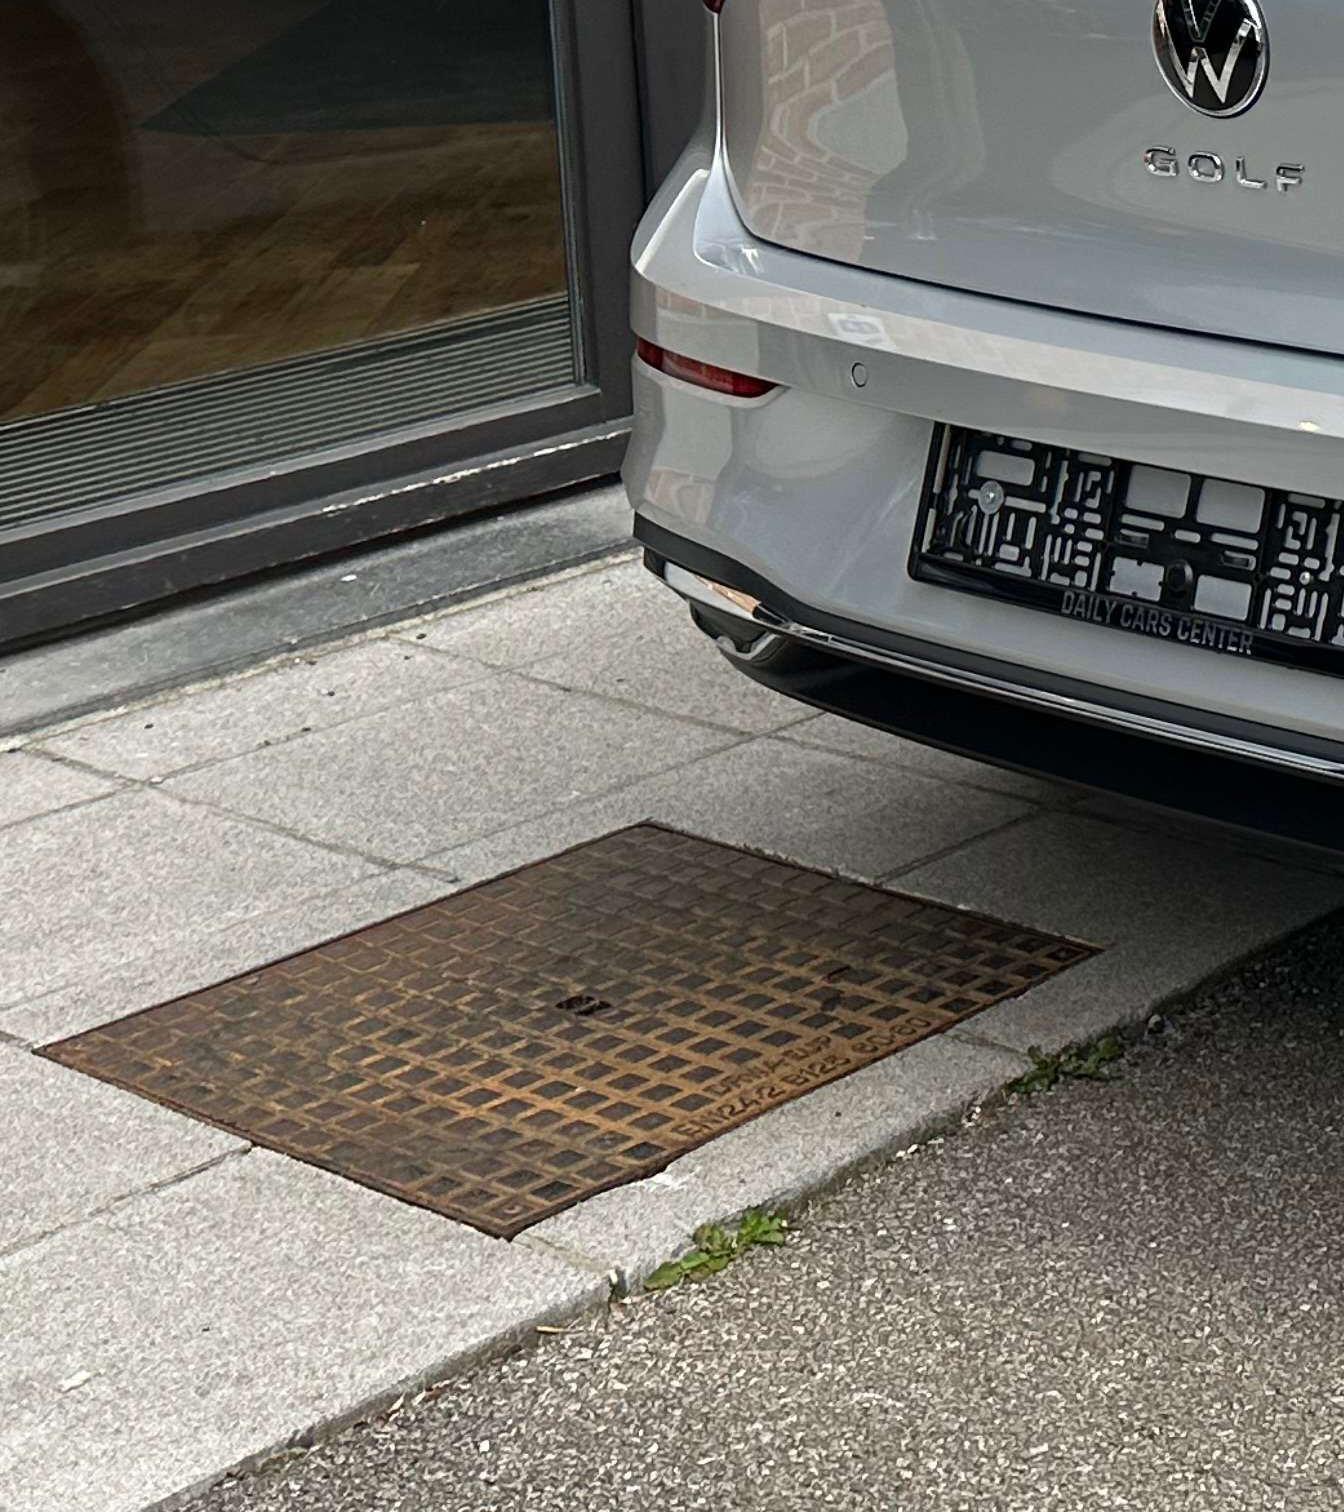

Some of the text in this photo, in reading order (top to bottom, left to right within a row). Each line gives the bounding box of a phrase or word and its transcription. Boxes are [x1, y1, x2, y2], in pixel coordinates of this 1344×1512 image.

[1143, 145, 1306, 192] GOLF
[1060, 589, 1254, 655] DAILY CARS CENTER
